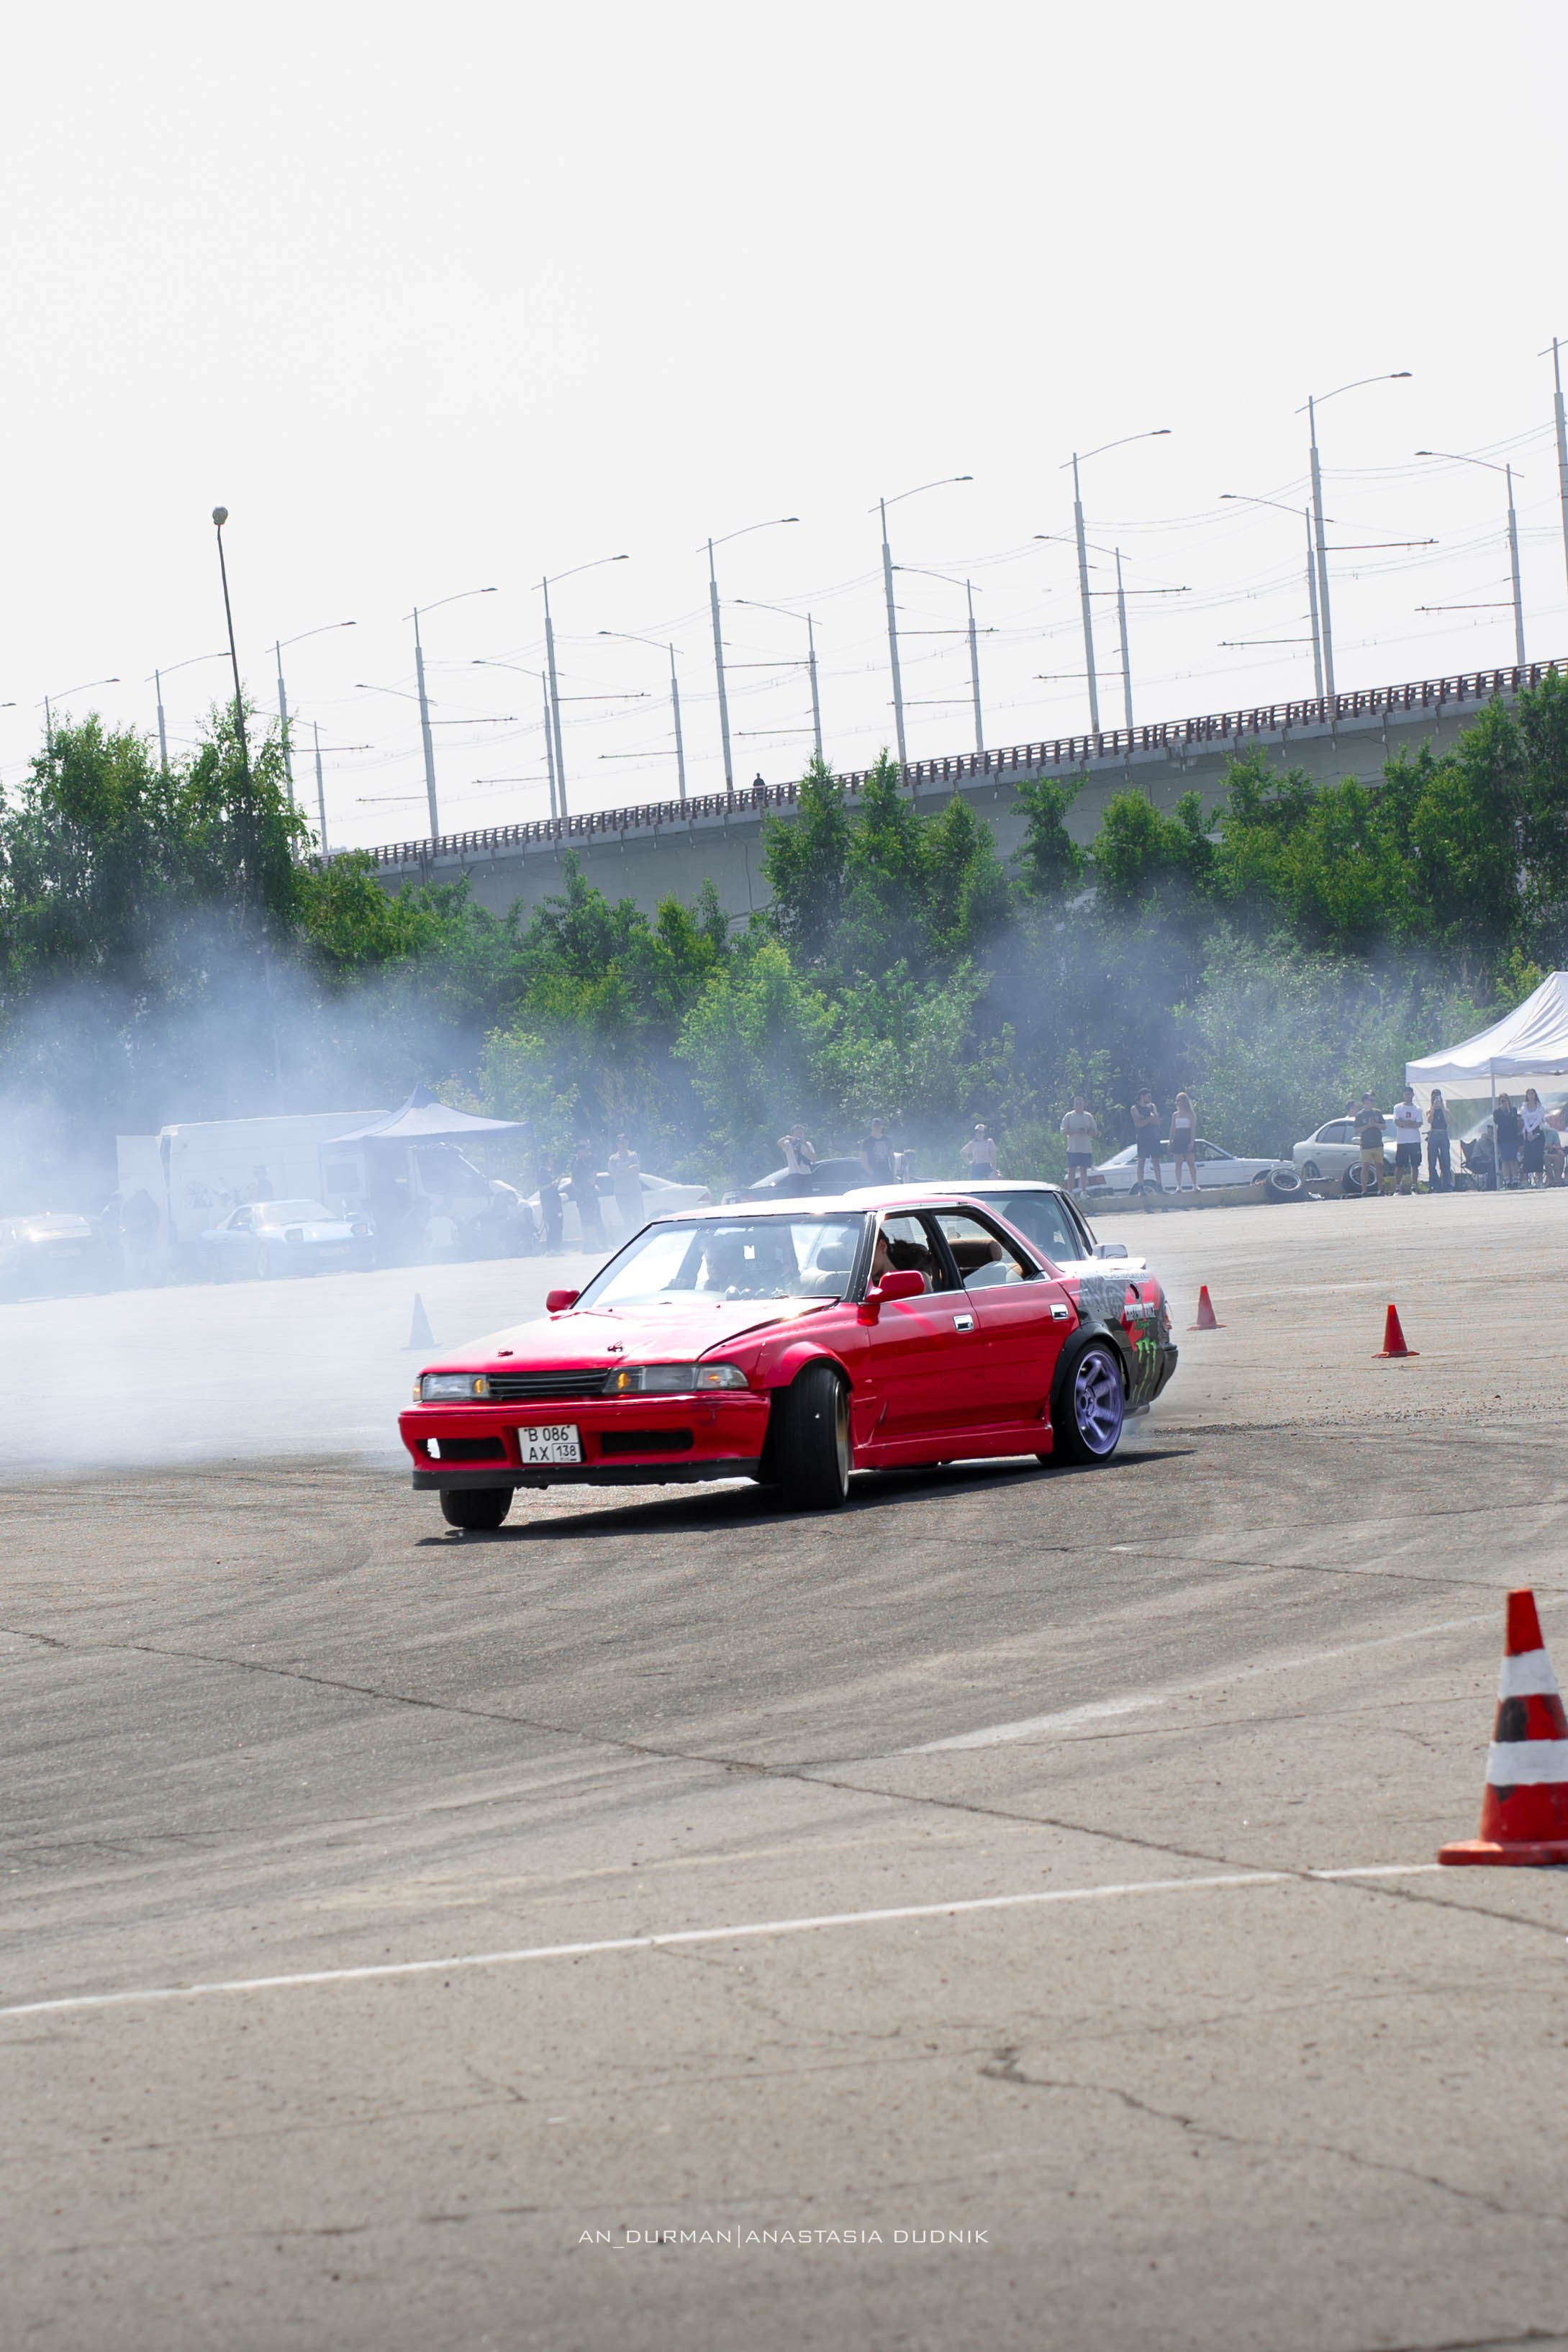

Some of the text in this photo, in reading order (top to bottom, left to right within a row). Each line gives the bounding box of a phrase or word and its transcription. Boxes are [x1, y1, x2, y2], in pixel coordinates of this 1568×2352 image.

[528, 1426, 568, 1442] B 086
[529, 1447, 550, 1461] AX
[556, 1444, 576, 1457] 138
